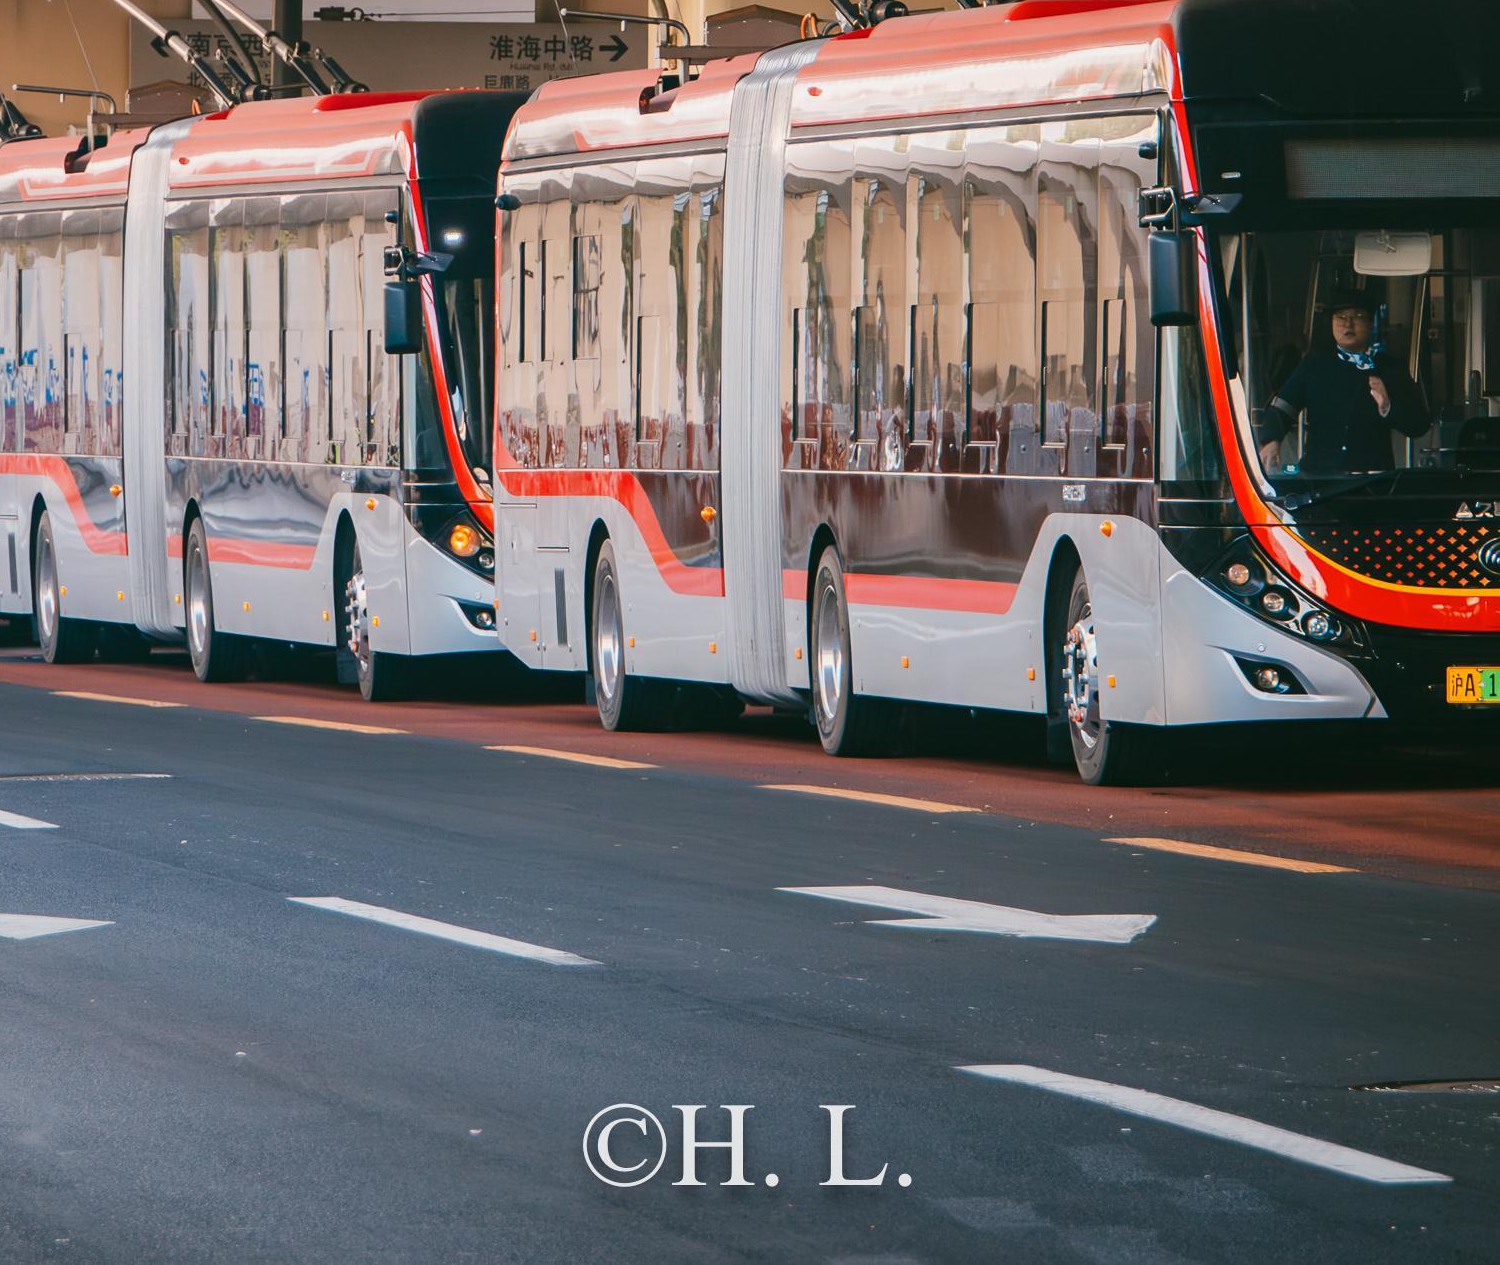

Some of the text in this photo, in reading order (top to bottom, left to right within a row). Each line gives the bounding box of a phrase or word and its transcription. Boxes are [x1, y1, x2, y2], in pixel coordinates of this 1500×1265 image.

[187, 31, 264, 58] 南京西
[489, 34, 594, 61] 淮海中路
[1451, 673, 1476, 696] 沪A
